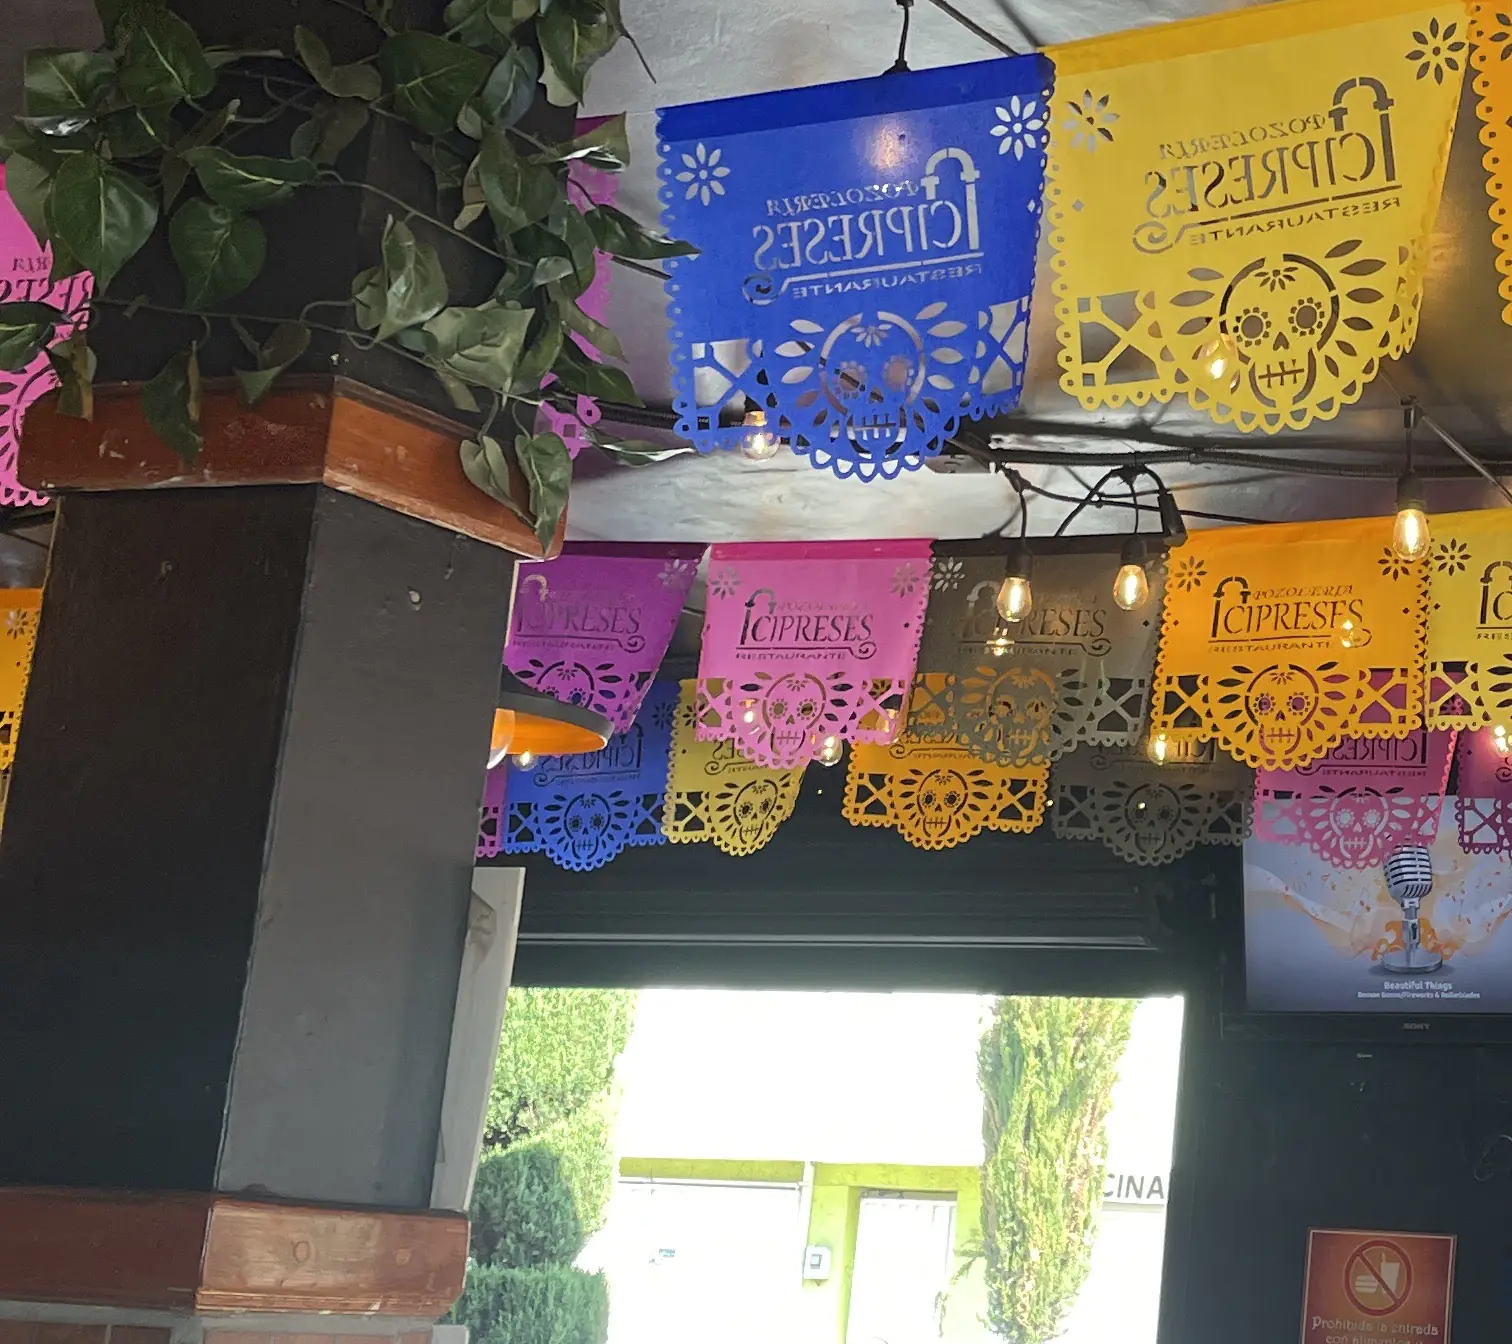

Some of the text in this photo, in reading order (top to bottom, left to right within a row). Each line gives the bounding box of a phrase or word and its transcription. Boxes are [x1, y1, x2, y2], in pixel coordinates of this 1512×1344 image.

[751, 615, 873, 642] CIPRESES
[1384, 981, 1452, 991] Beautiful Things
[1312, 1316, 1372, 1331] Prohibida
[1391, 1323, 1438, 1336] entrada
[1326, 1335, 1348, 1344] con
